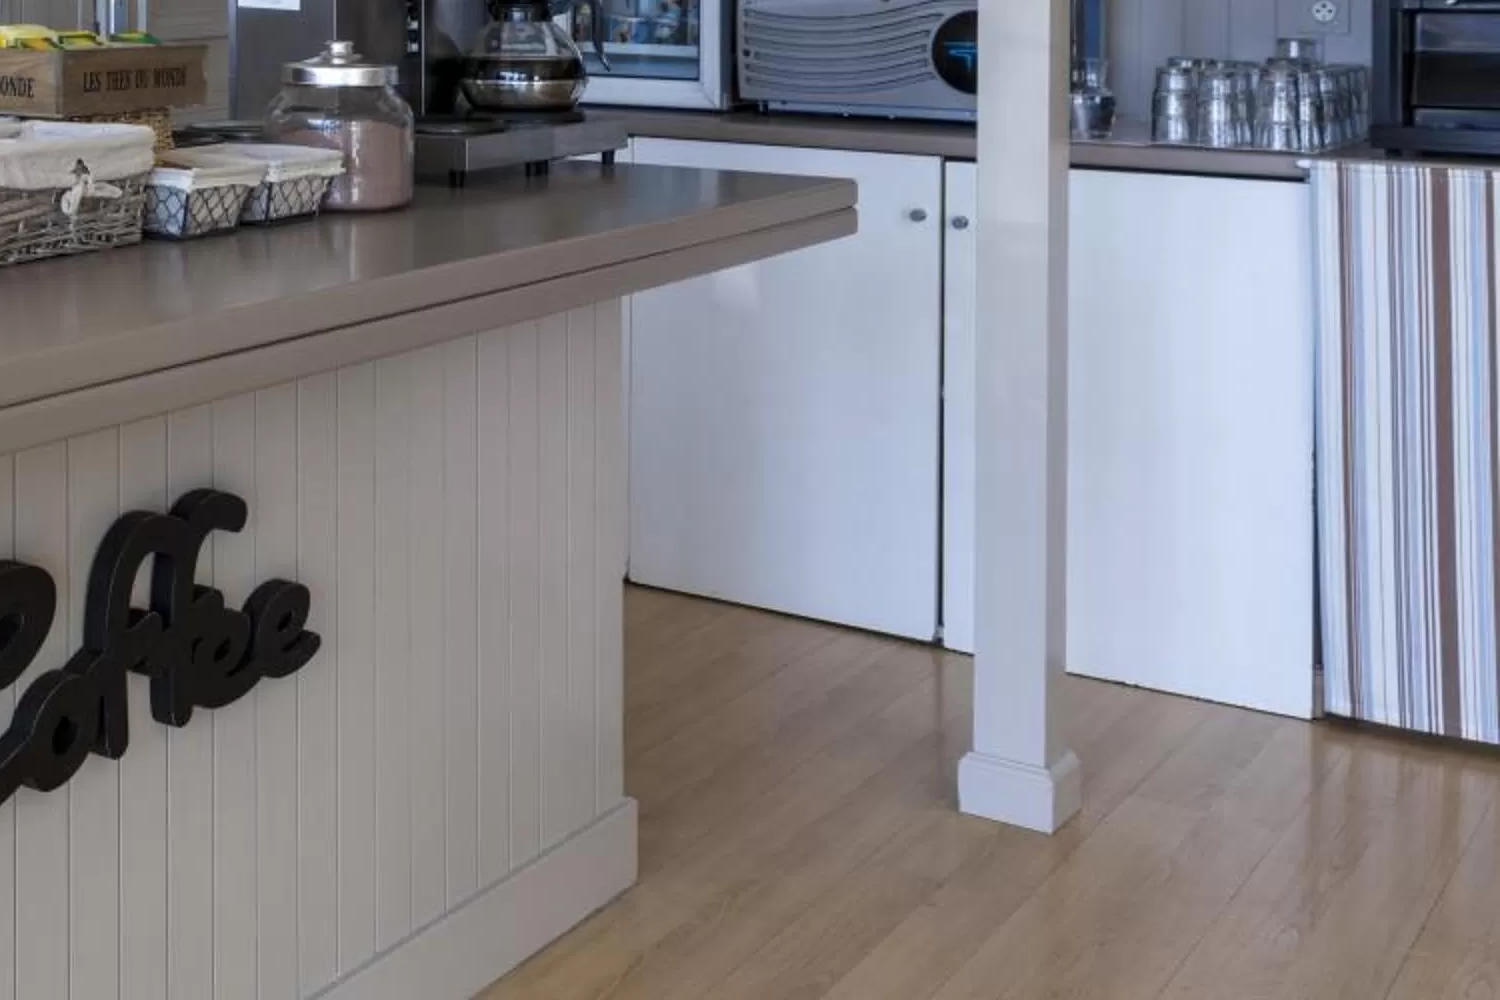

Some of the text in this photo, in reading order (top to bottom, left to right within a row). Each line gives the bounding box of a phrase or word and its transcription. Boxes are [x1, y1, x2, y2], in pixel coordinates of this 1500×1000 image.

[83, 72, 102, 92] LES
[135, 69, 148, 89] DU
[153, 66, 188, 89] MONDE
